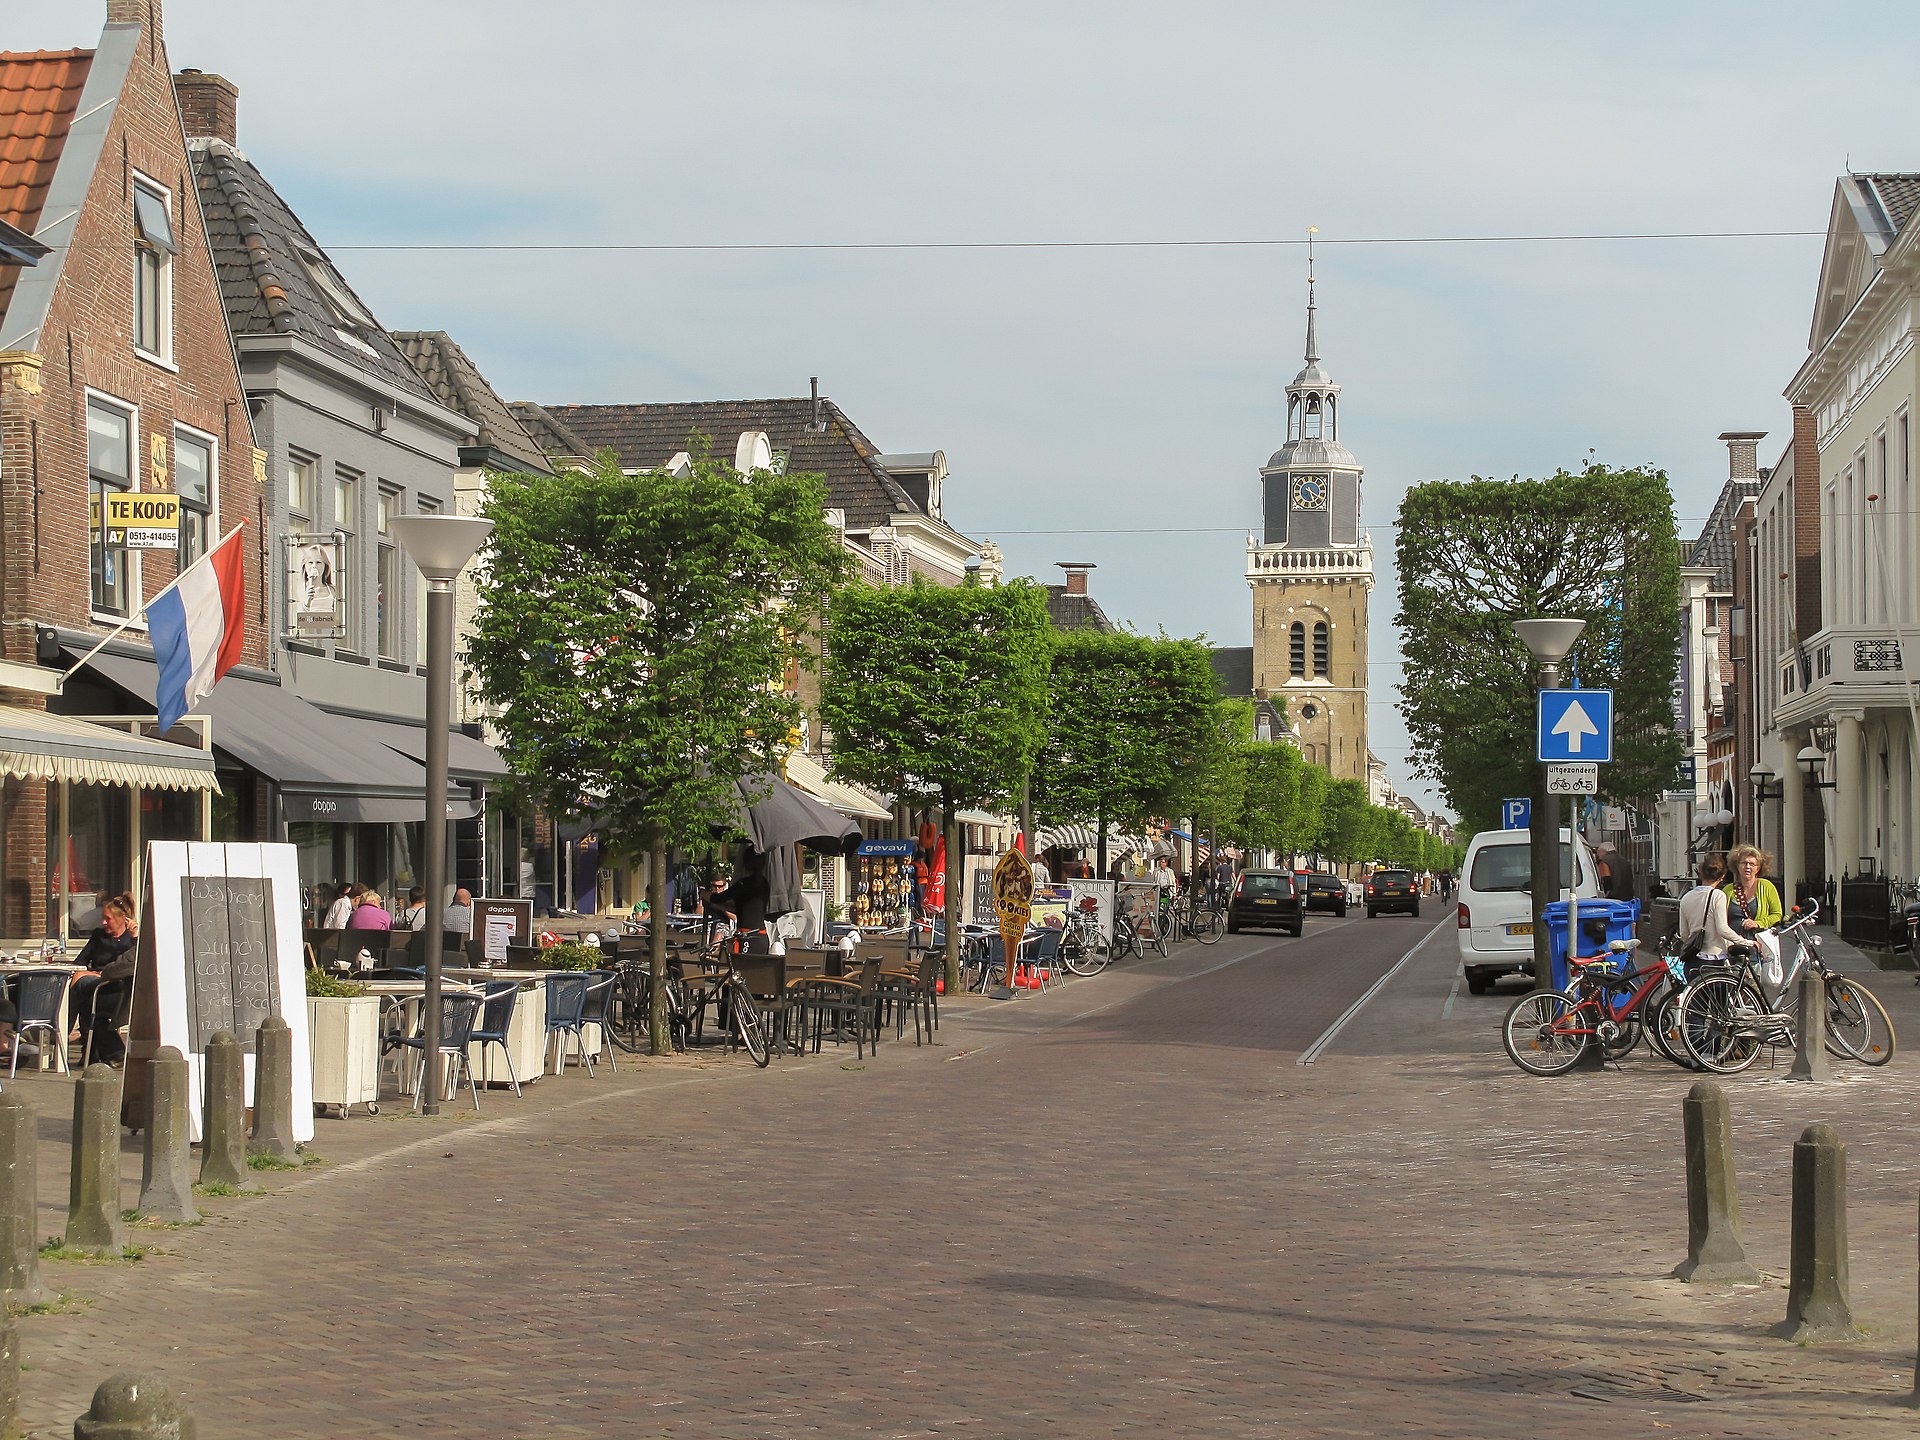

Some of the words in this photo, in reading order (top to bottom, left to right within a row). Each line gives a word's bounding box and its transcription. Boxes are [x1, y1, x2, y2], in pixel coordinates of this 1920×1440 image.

[110, 501, 129, 518] TE
[133, 501, 177, 519] KOOP
[108, 530, 125, 543] A7
[129, 531, 177, 541] 0513-414055
[1549, 766, 1596, 774] uitgezonderd
[312, 798, 338, 814] doppio
[1509, 801, 1525, 824] P
[865, 843, 907, 852] gevavi
[996, 899, 1029, 918] COOKIES
[1003, 920, 1021, 931] Gelato
